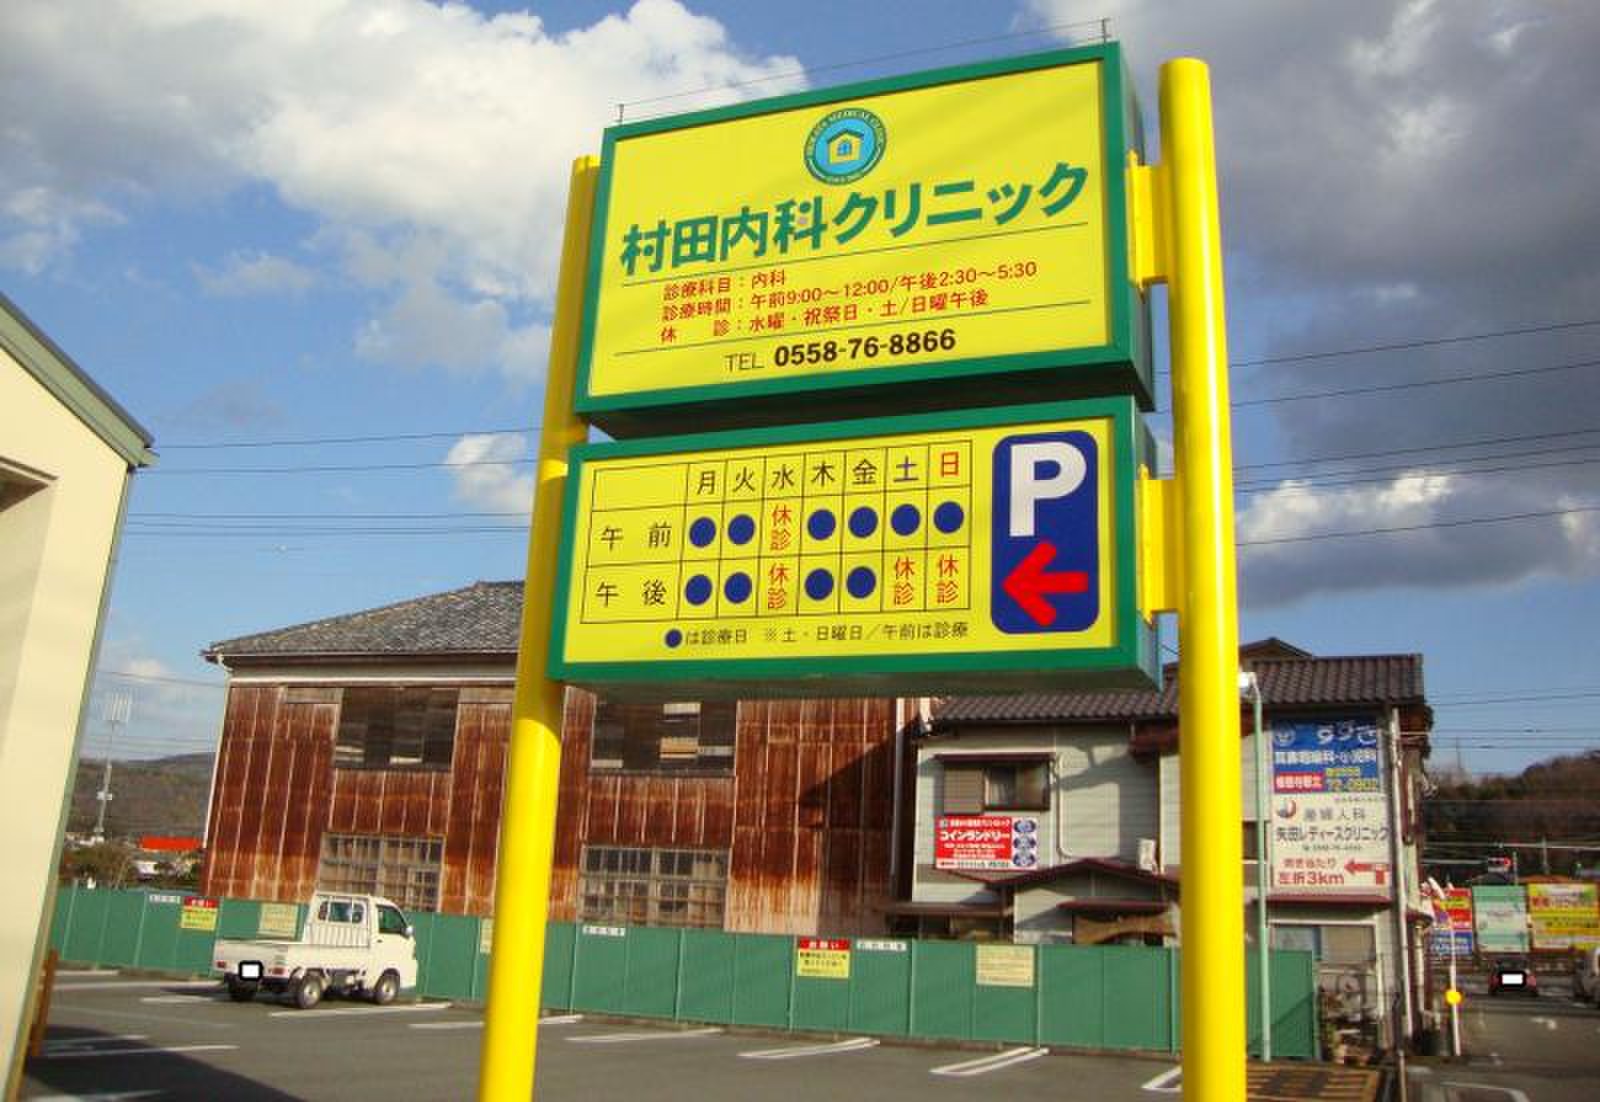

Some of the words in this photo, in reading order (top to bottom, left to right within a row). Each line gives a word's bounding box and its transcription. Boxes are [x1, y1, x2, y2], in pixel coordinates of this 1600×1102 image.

[620, 162, 1089, 275] 村田内科クリニック
[724, 352, 765, 373] TEL
[774, 328, 957, 368] 0558-76-8866
[697, 470, 716, 495] 月
[732, 466, 756, 492] 火
[771, 464, 794, 490] 水
[811, 460, 836, 487] 木
[852, 458, 877, 485] 金
[893, 456, 919, 483] 土
[940, 451, 960, 478] 日
[1009, 441, 1087, 537] P
[769, 504, 792, 551] 休診
[767, 562, 789, 610] 休診
[893, 557, 916, 606] 休診
[937, 554, 959, 605] 休診
